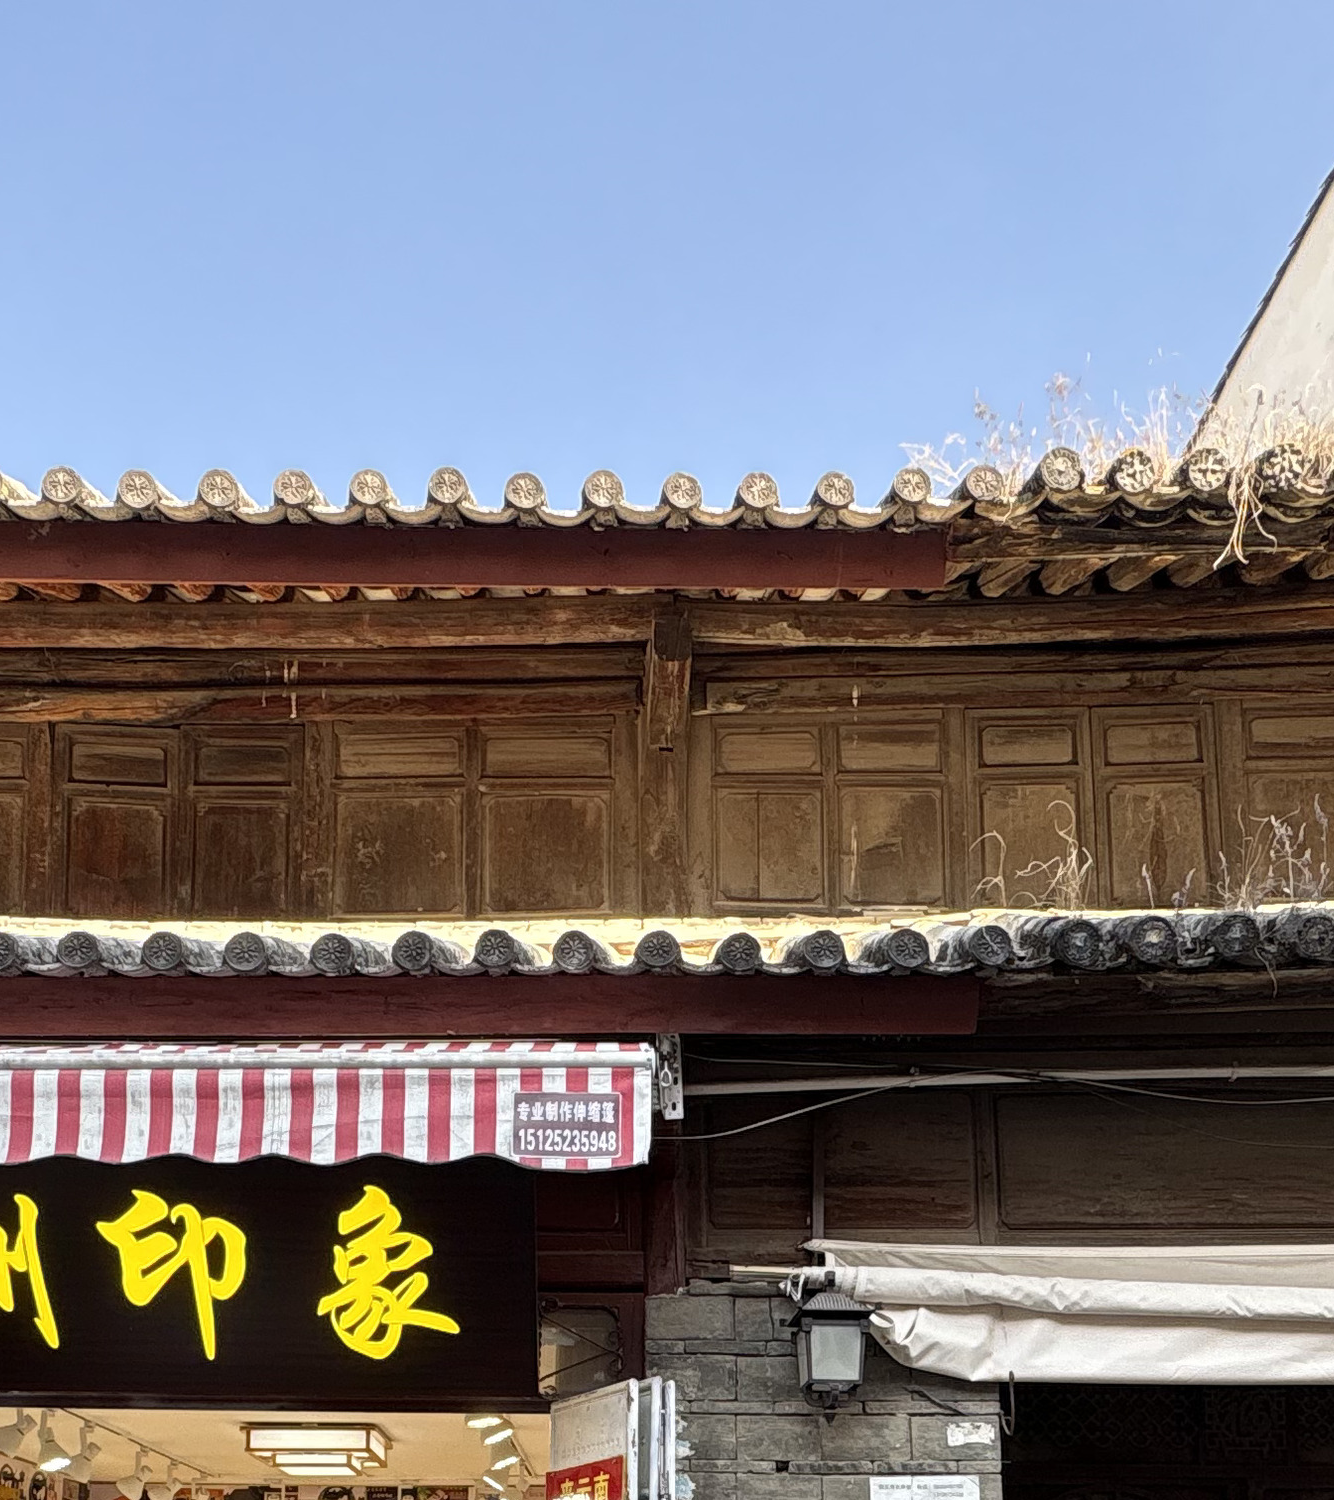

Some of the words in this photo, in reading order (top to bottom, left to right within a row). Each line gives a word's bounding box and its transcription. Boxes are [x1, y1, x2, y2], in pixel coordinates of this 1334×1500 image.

[517, 1101, 616, 1123] 专业制作伸缩篷
[518, 1128, 617, 1152] 15125235948
